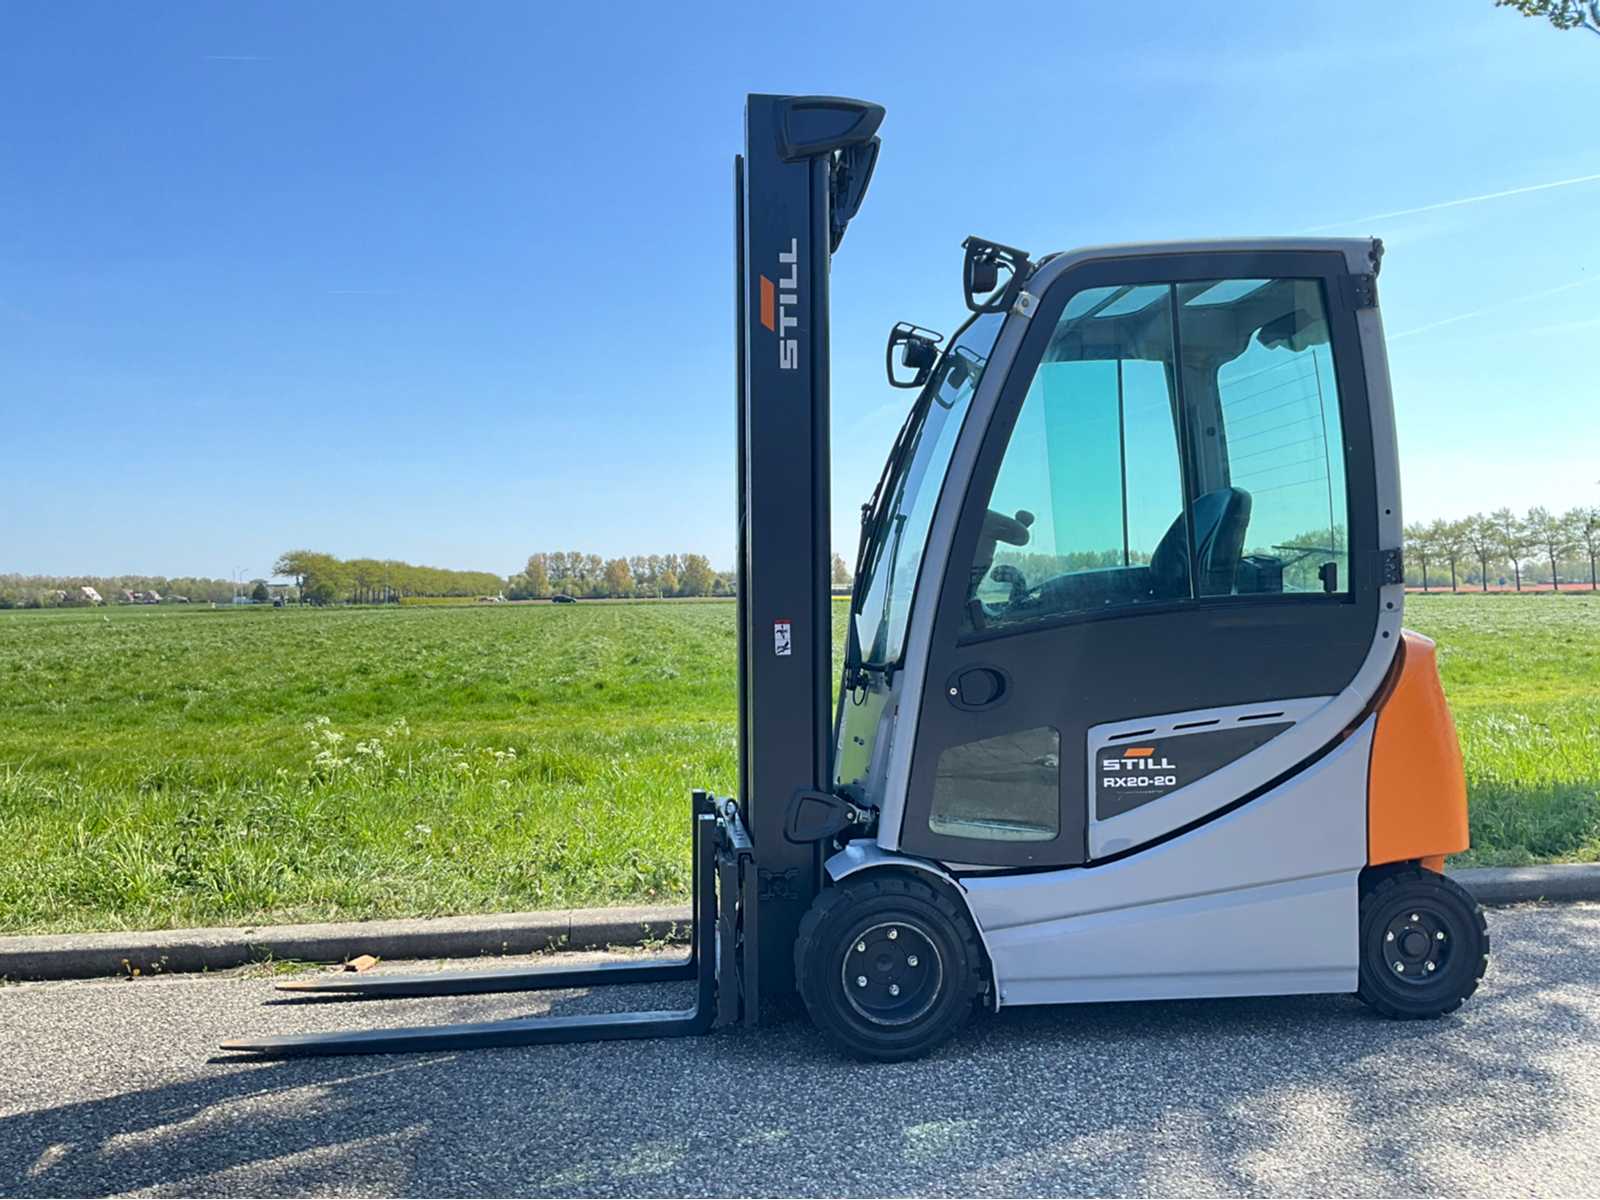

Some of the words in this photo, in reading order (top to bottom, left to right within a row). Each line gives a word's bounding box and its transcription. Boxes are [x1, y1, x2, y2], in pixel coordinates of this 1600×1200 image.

[779, 238, 798, 369] STILL
[1103, 758, 1176, 770] STILL
[1103, 776, 1176, 787] RX20-20
